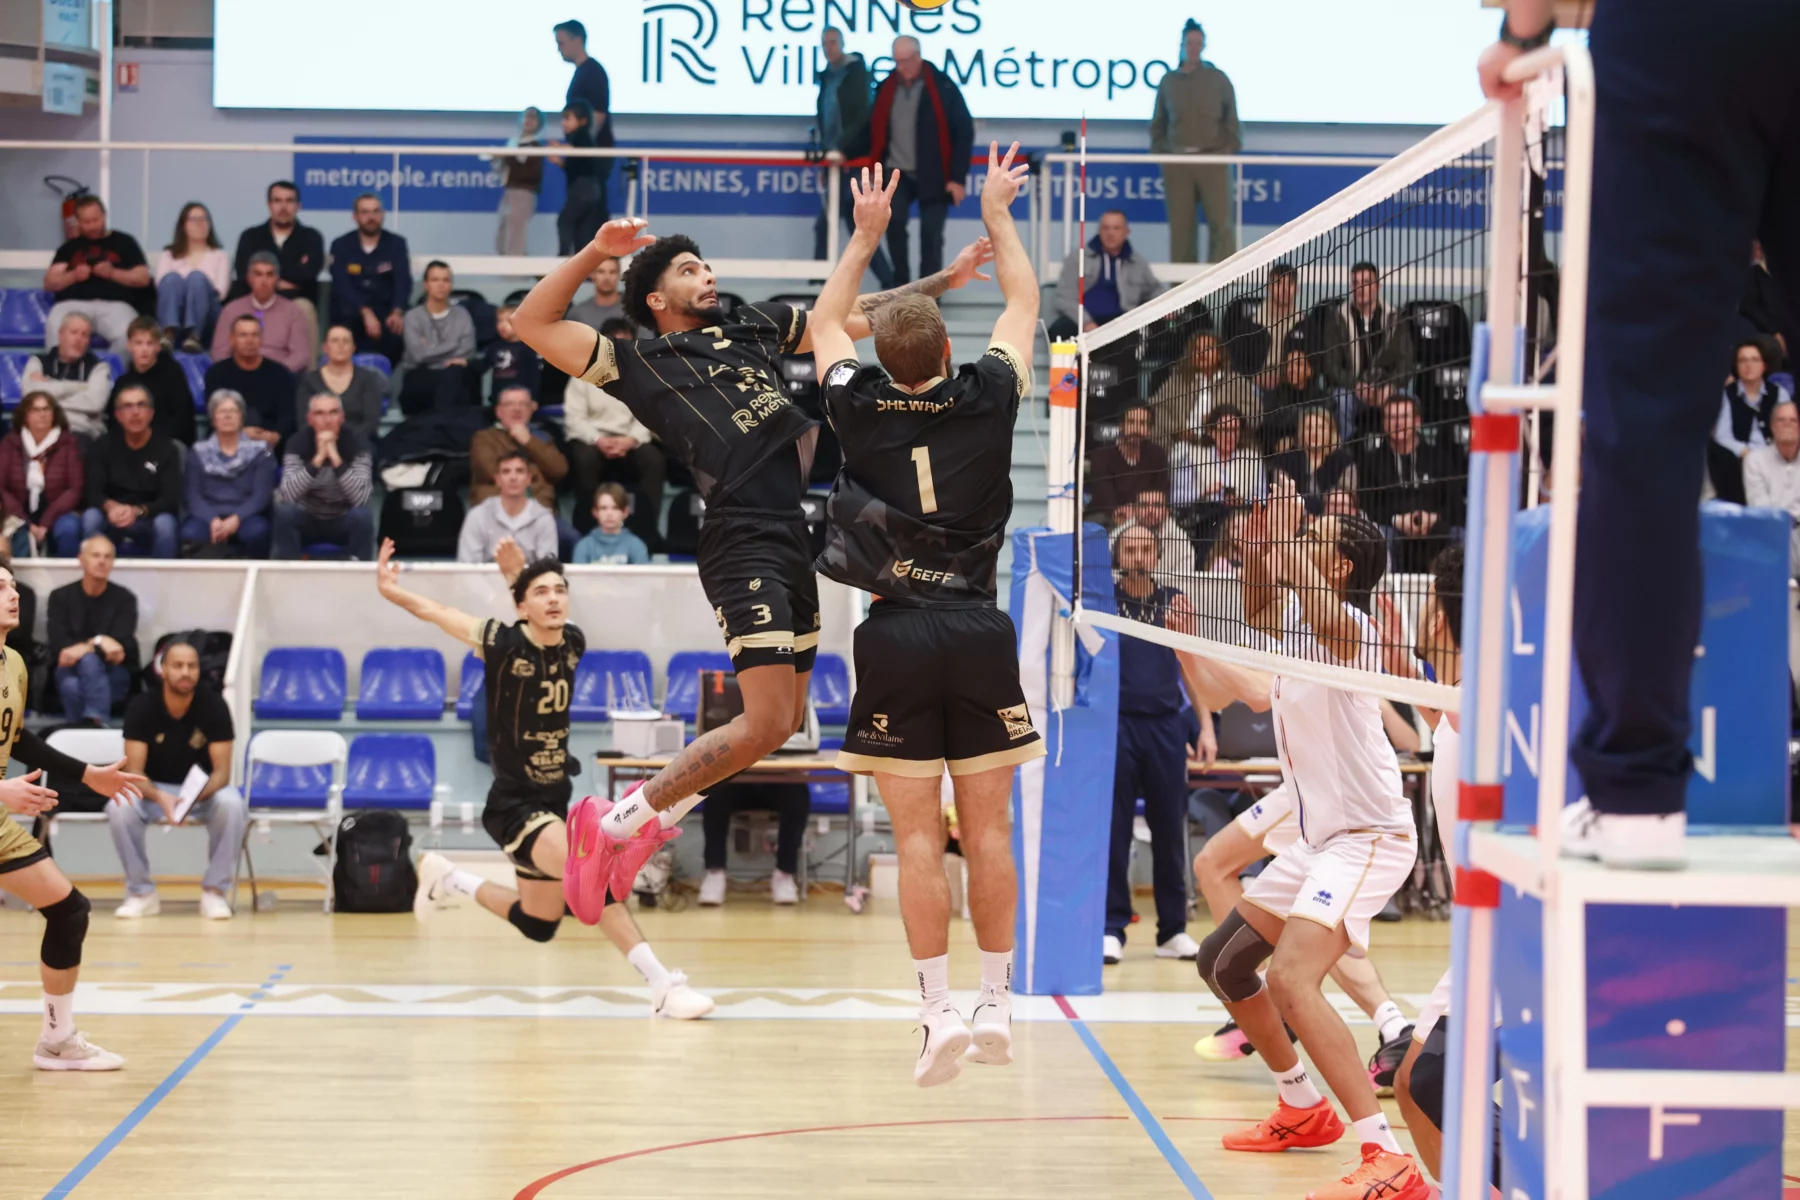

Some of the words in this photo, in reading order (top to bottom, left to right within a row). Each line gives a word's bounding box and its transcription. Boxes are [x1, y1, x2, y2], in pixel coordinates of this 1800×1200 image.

[741, 44, 819, 84] Vill
[943, 46, 1172, 100] Métropo
[757, 167, 827, 194] FIDÈL
[911, 446, 937, 514] 1
[911, 566, 955, 584] GEFF
[751, 603, 772, 625] 3
[537, 678, 569, 714] 20
